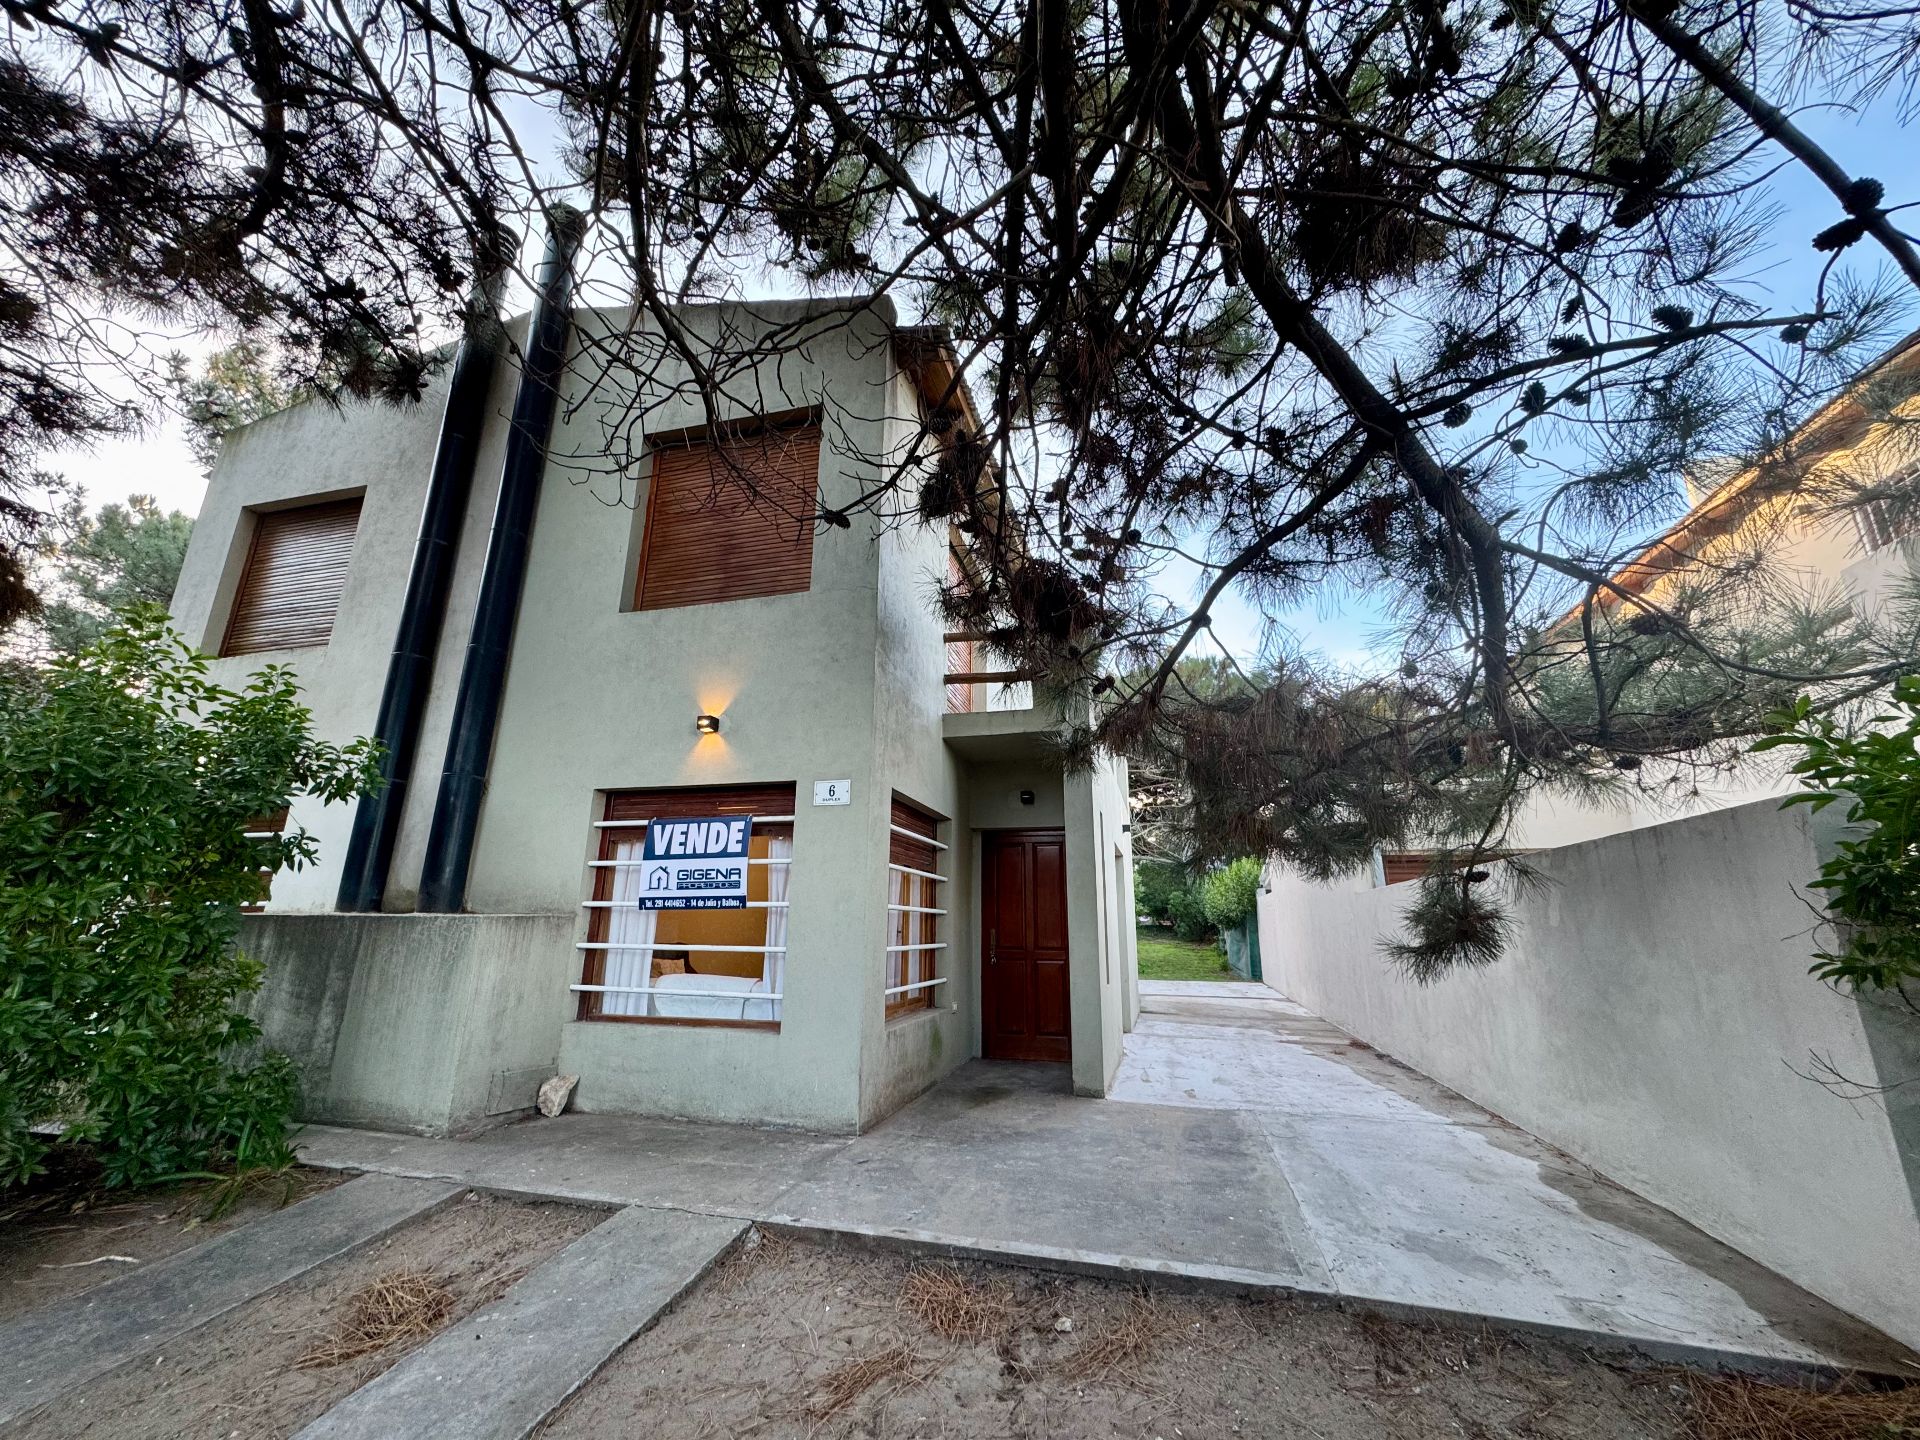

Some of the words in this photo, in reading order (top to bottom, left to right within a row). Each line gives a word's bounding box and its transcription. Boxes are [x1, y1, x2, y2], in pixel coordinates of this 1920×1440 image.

[829, 785, 836, 797] 6
[653, 821, 746, 855] VENDE
[677, 868, 741, 880] GIGENA
[645, 899, 654, 908] Tel.
[654, 899, 664, 908] 291
[697, 898, 705, 907] de
[717, 900, 722, 908] y
